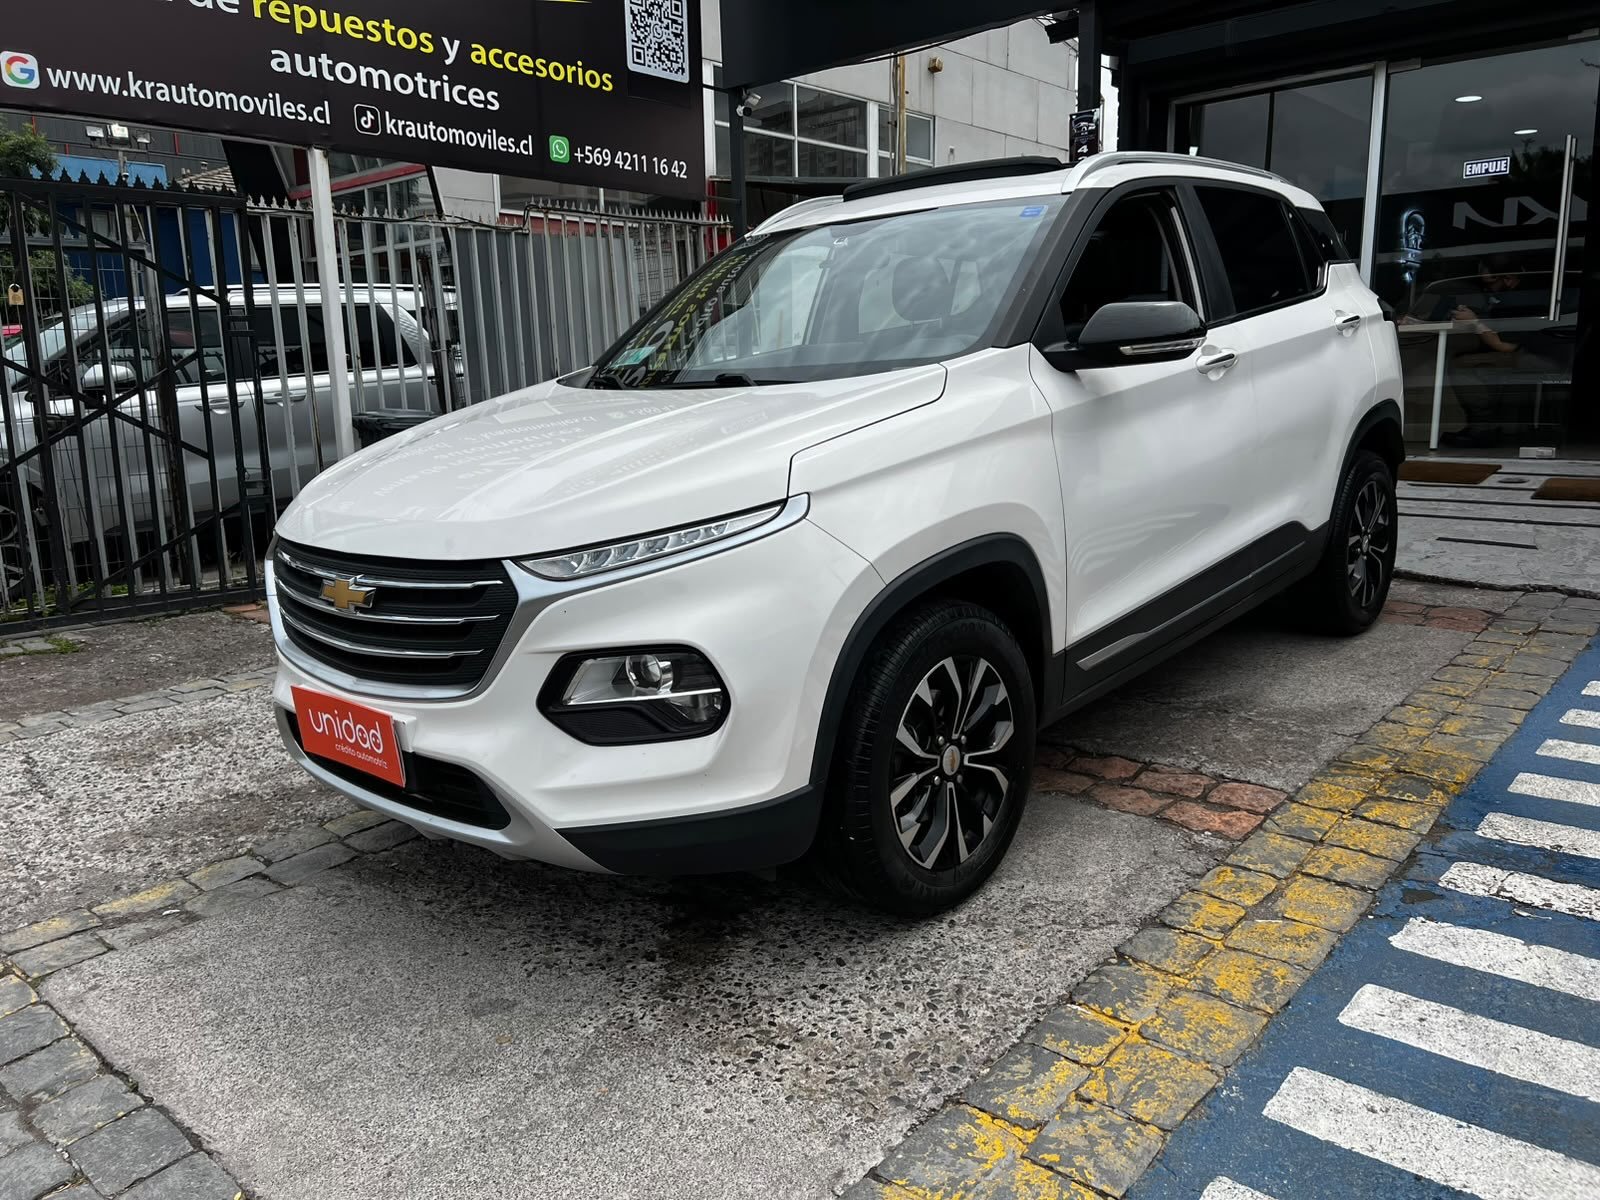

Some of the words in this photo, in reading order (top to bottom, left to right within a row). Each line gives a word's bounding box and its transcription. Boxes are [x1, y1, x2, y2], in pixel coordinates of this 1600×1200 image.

[188, 0, 240, 14] e
[252, 0, 434, 54] repuestos
[441, 36, 461, 66] y
[470, 43, 614, 92] accesorios
[46, 67, 331, 125] www.krautomoviles.cl
[270, 49, 501, 111] automotrices
[385, 110, 533, 156] krautomoviles.cl
[573, 146, 612, 167] +569
[614, 150, 648, 173] 4211
[651, 156, 669, 176] 16
[670, 160, 688, 179] 42
[1465, 159, 1508, 176] EMPUJE
[308, 708, 384, 754] unidad
